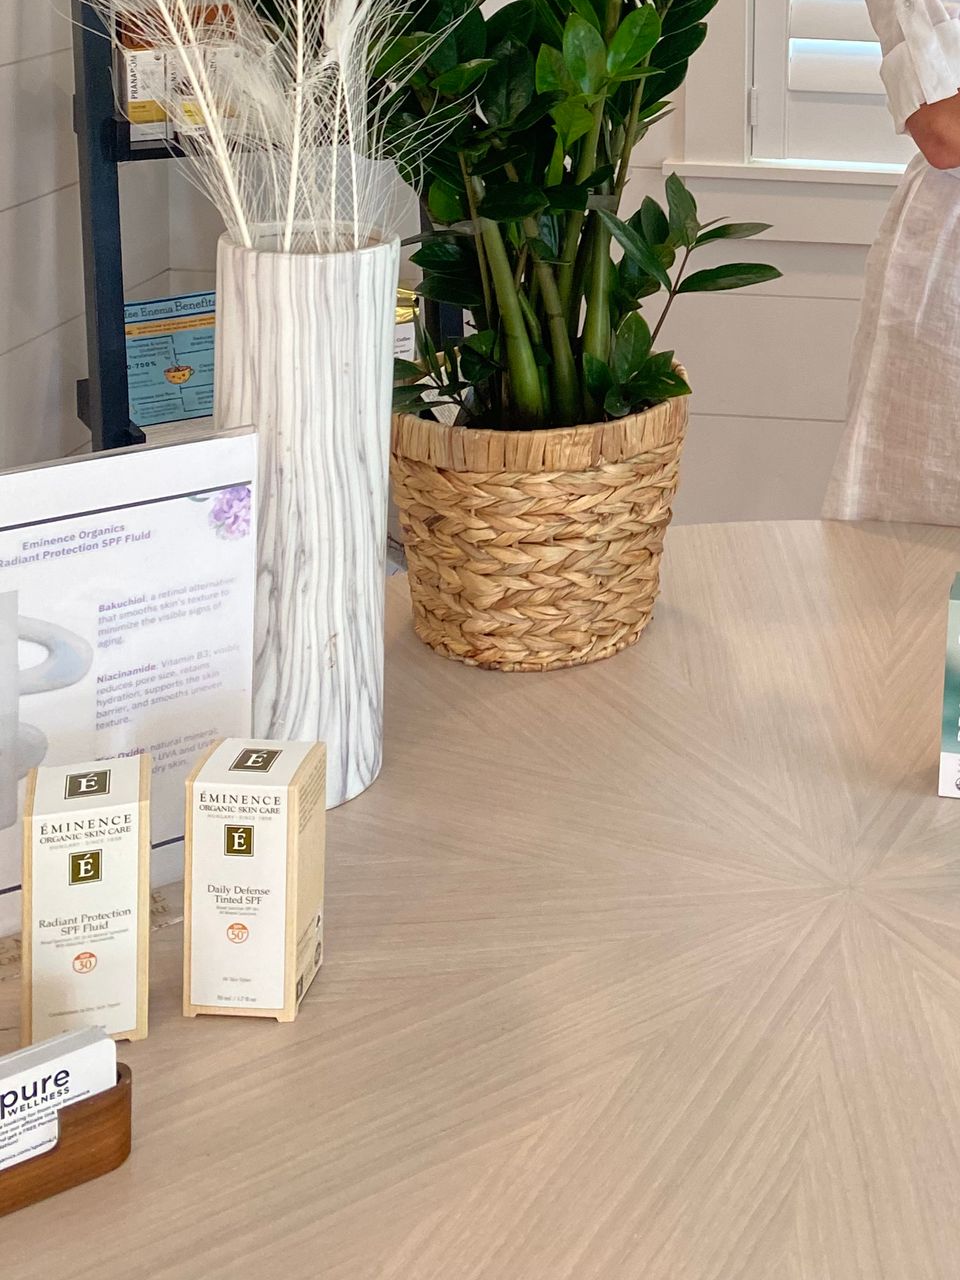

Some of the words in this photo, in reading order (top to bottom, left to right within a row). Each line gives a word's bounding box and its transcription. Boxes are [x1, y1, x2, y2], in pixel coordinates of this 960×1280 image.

[140, 306, 174, 317] Enema
[22, 533, 76, 550] Eminence
[78, 524, 125, 540] Organics
[42, 542, 98, 560] Protection
[102, 536, 122, 548] SPF
[124, 530, 152, 544] Fluid
[98, 612, 116, 626] that
[119, 604, 158, 622] smooths
[160, 597, 186, 612] skin's
[187, 591, 220, 606] texture
[221, 588, 230, 598] to
[98, 622, 139, 636] minimize
[141, 616, 156, 626] the
[158, 609, 186, 622] visible
[161, 654, 194, 668] Vitamin
[97, 681, 134, 696] reduces
[136, 674, 156, 689] pore
[144, 678, 184, 696] supports
[186, 674, 200, 684] the
[132, 698, 149, 710] and
[179, 744, 196, 755] and
[200, 790, 281, 806] ÉMINENCE
[199, 804, 236, 813] ORGANIC
[238, 806, 258, 814] SKIN
[258, 806, 280, 814] CARE
[40, 814, 132, 836] ÉMINENCE
[40, 833, 83, 845] ORGANIC
[84, 828, 106, 839] SKIN
[108, 825, 132, 836] CARE
[232, 829, 247, 850] É
[78, 854, 94, 878] É
[207, 884, 232, 896] Daily
[234, 886, 270, 896] Defense
[214, 894, 244, 904] Tinted
[245, 896, 262, 906] SPF
[38, 915, 78, 930] Radiant
[80, 908, 132, 922] Protection
[60, 924, 80, 937] SPF
[82, 920, 109, 934] Fluid
[78, 959, 92, 970] 30
[0, 1069, 70, 1120] pure
[8, 1086, 70, 1116] WELLNESS
